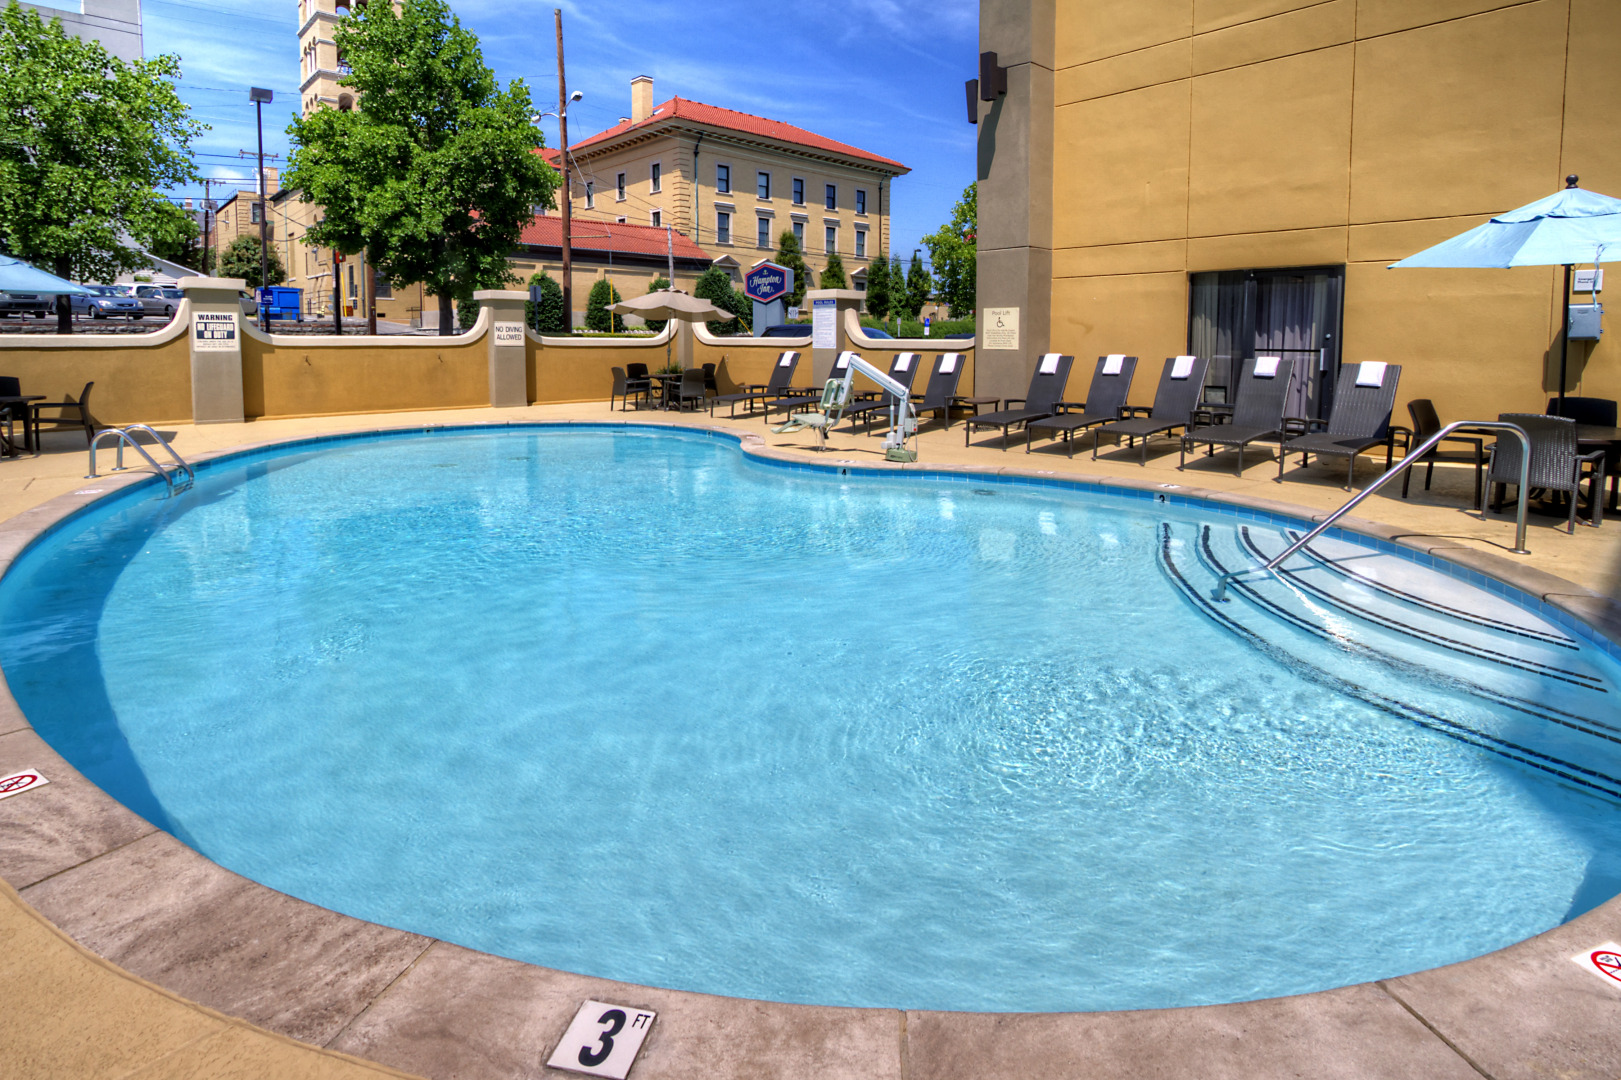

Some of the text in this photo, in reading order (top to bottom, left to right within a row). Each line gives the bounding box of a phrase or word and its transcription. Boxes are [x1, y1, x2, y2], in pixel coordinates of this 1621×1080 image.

[750, 275, 782, 287] Hampton
[757, 284, 773, 295] Inn
[206, 323, 234, 331] LIFEGUARD
[203, 330, 228, 338] ON DUTY
[578, 1009, 651, 1067] 3 FT
